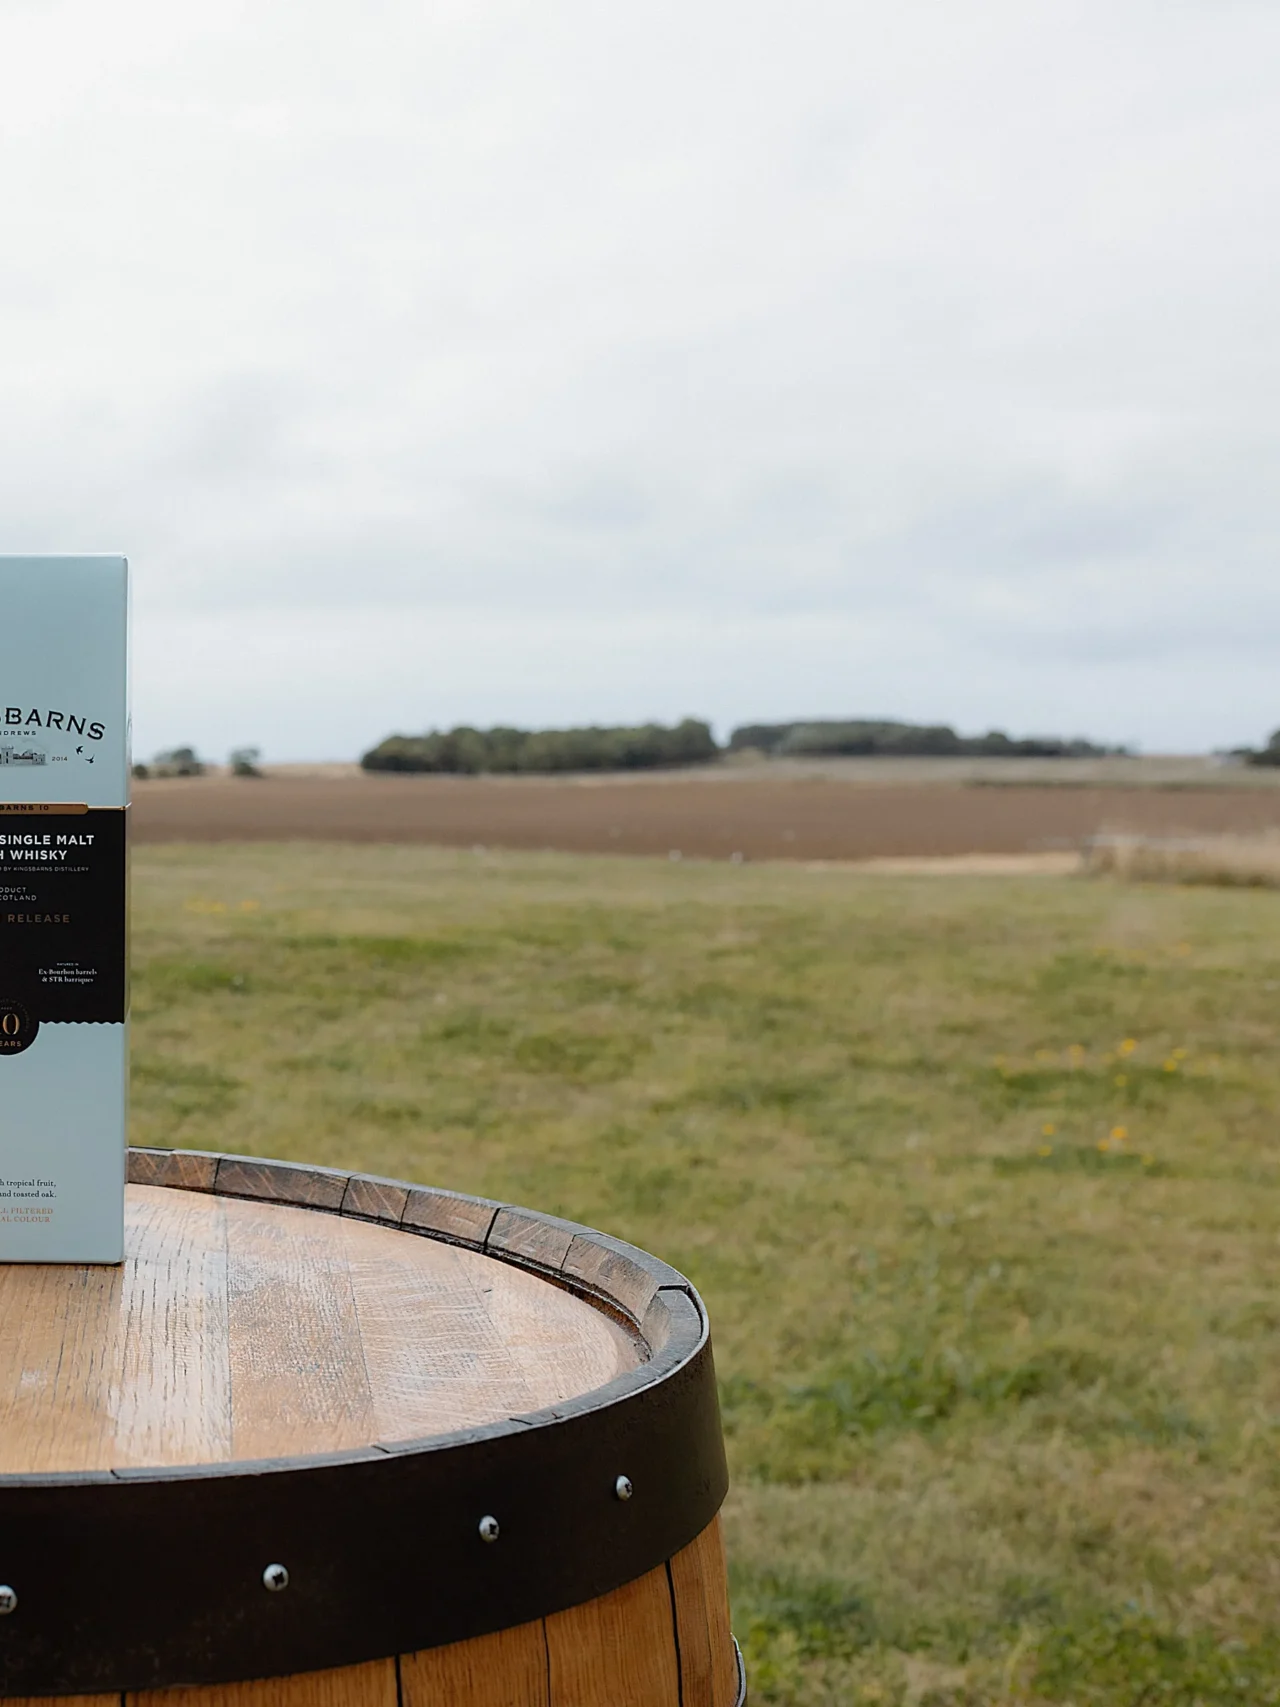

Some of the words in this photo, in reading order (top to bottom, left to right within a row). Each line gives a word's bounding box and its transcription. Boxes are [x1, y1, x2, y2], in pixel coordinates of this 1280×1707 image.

[56, 834, 95, 845] MALT
[10, 850, 67, 861] WHISKY
[8, 913, 71, 923] RELEASE
[64, 976, 94, 985] barriques
[6, 1179, 35, 1188] tropical
[37, 1179, 56, 1187] fruit,
[13, 1190, 39, 1198] toasted
